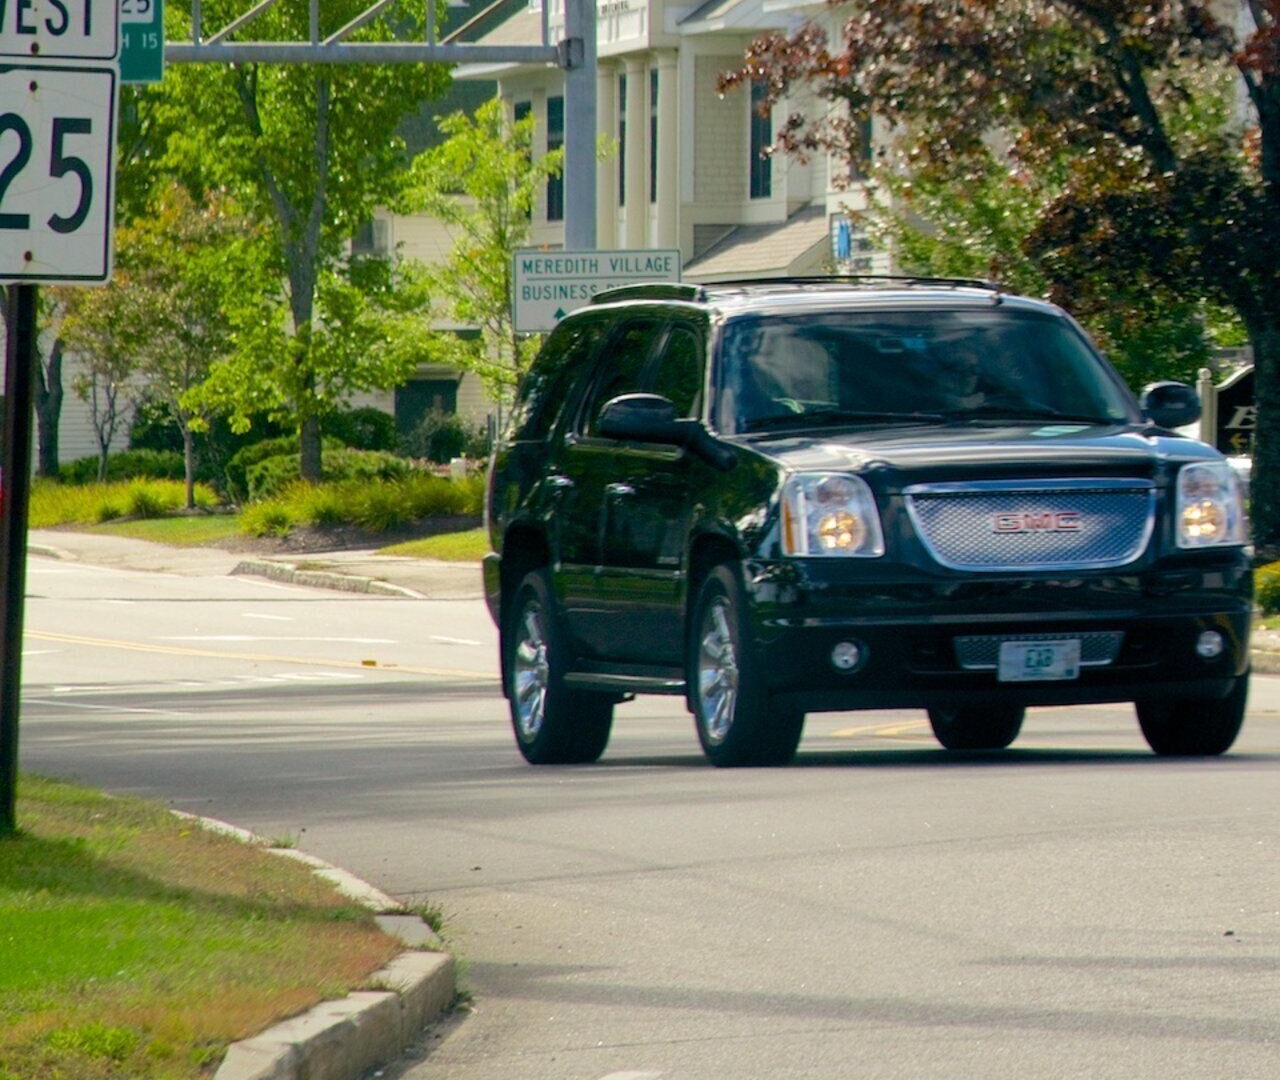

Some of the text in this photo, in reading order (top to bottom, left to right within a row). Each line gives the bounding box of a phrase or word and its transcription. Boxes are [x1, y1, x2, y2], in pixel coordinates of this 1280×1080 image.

[0, 112, 93, 234] 25
[522, 256, 672, 274] MEREDITH VILLAGE
[522, 284, 598, 301] BUSINESS
[991, 512, 1081, 533] GMC
